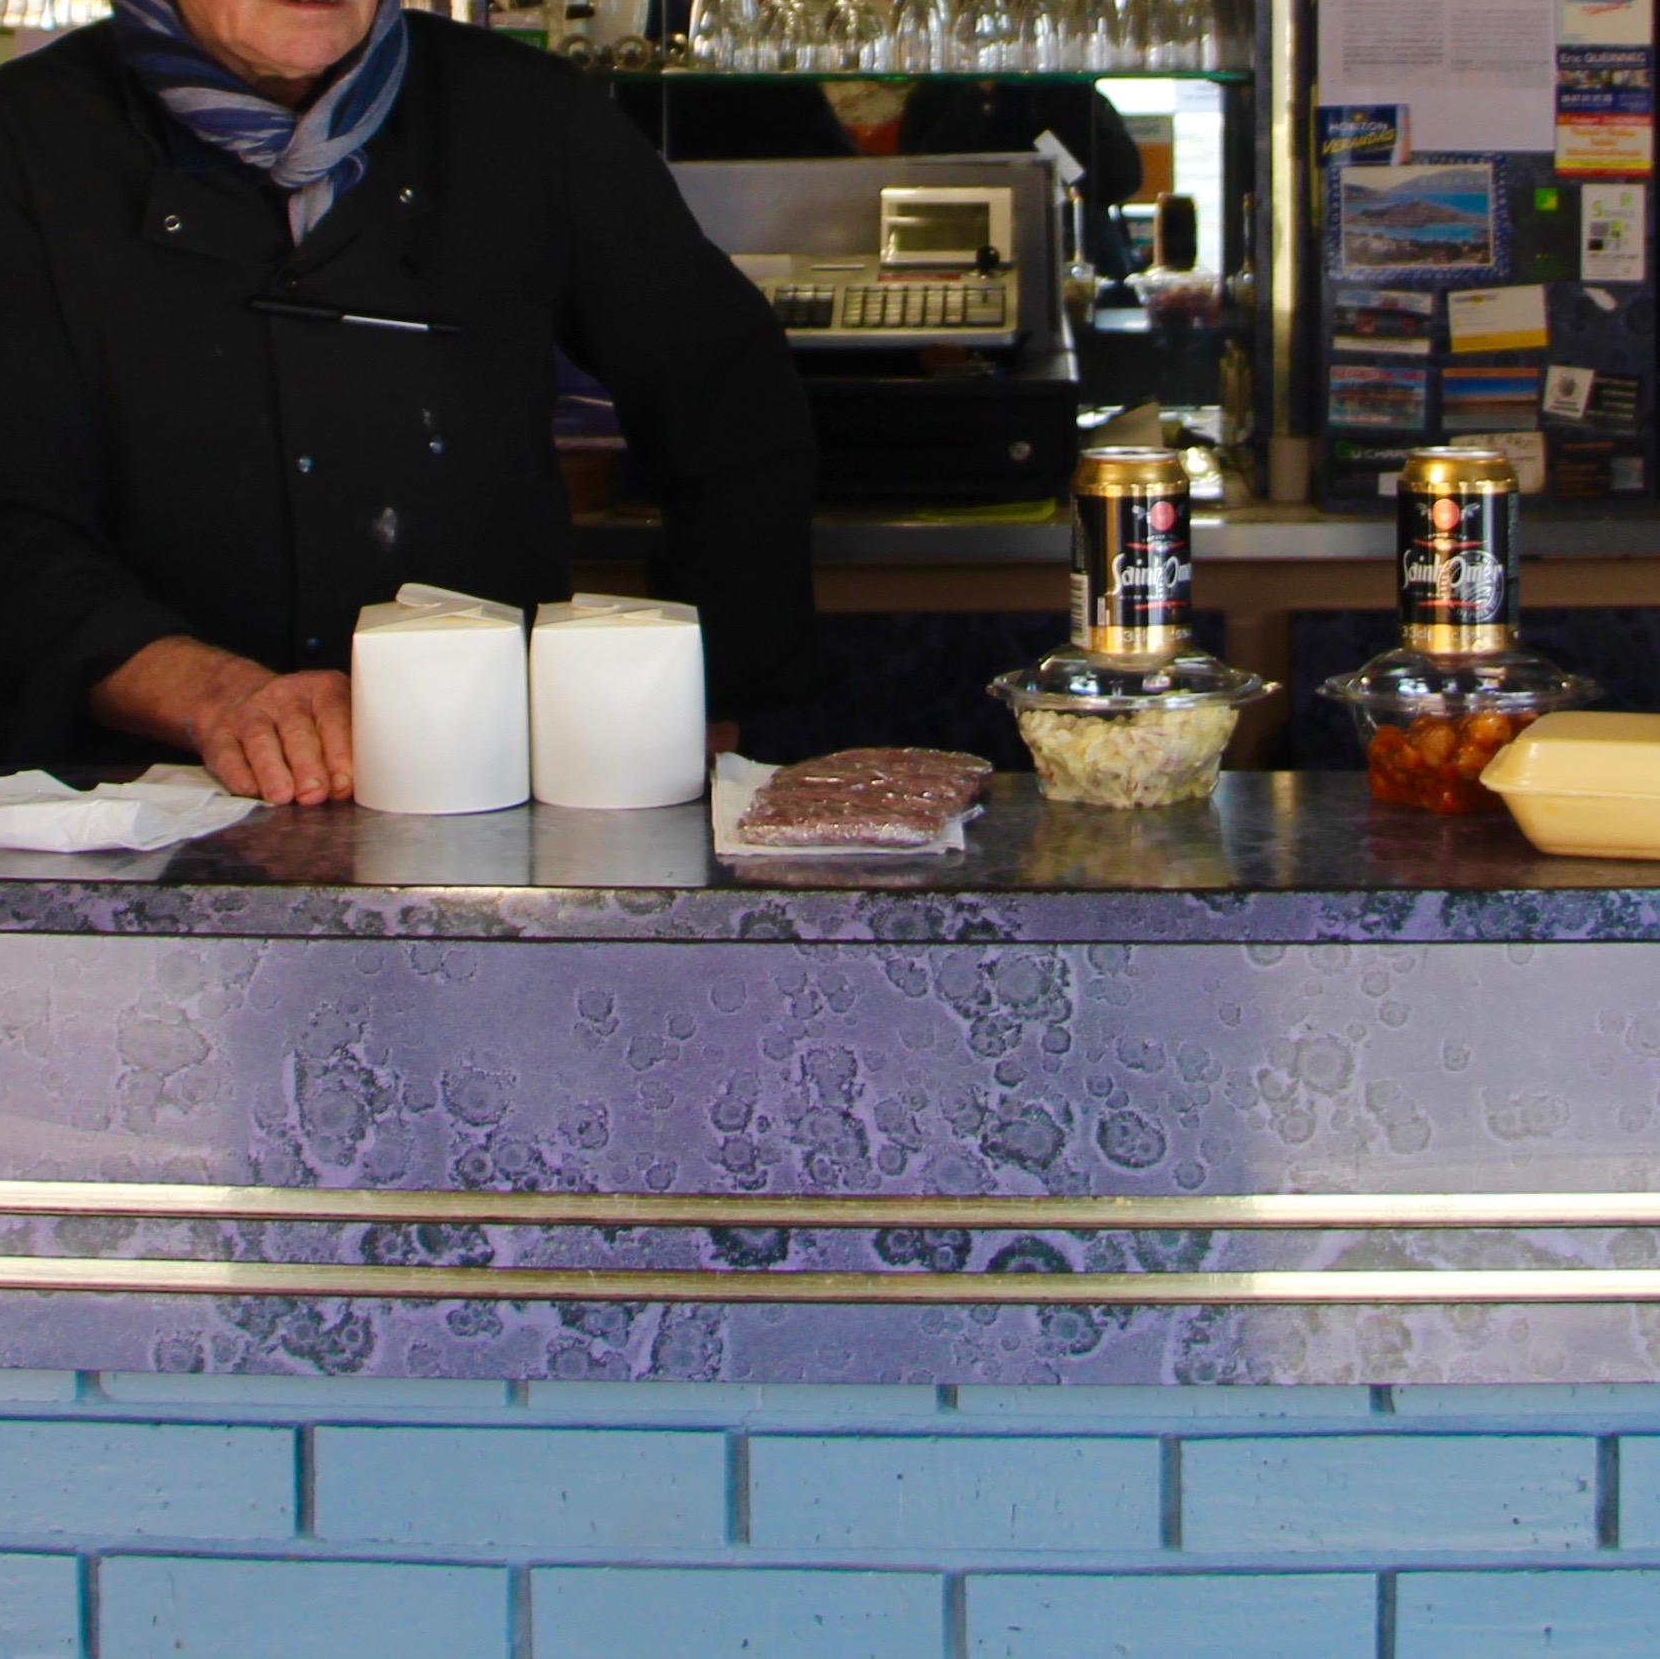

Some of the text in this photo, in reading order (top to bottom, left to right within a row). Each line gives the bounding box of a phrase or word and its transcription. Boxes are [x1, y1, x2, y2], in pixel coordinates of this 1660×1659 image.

[1105, 553, 1192, 595] Saint Om
[1403, 549, 1503, 589] Saint Omer
